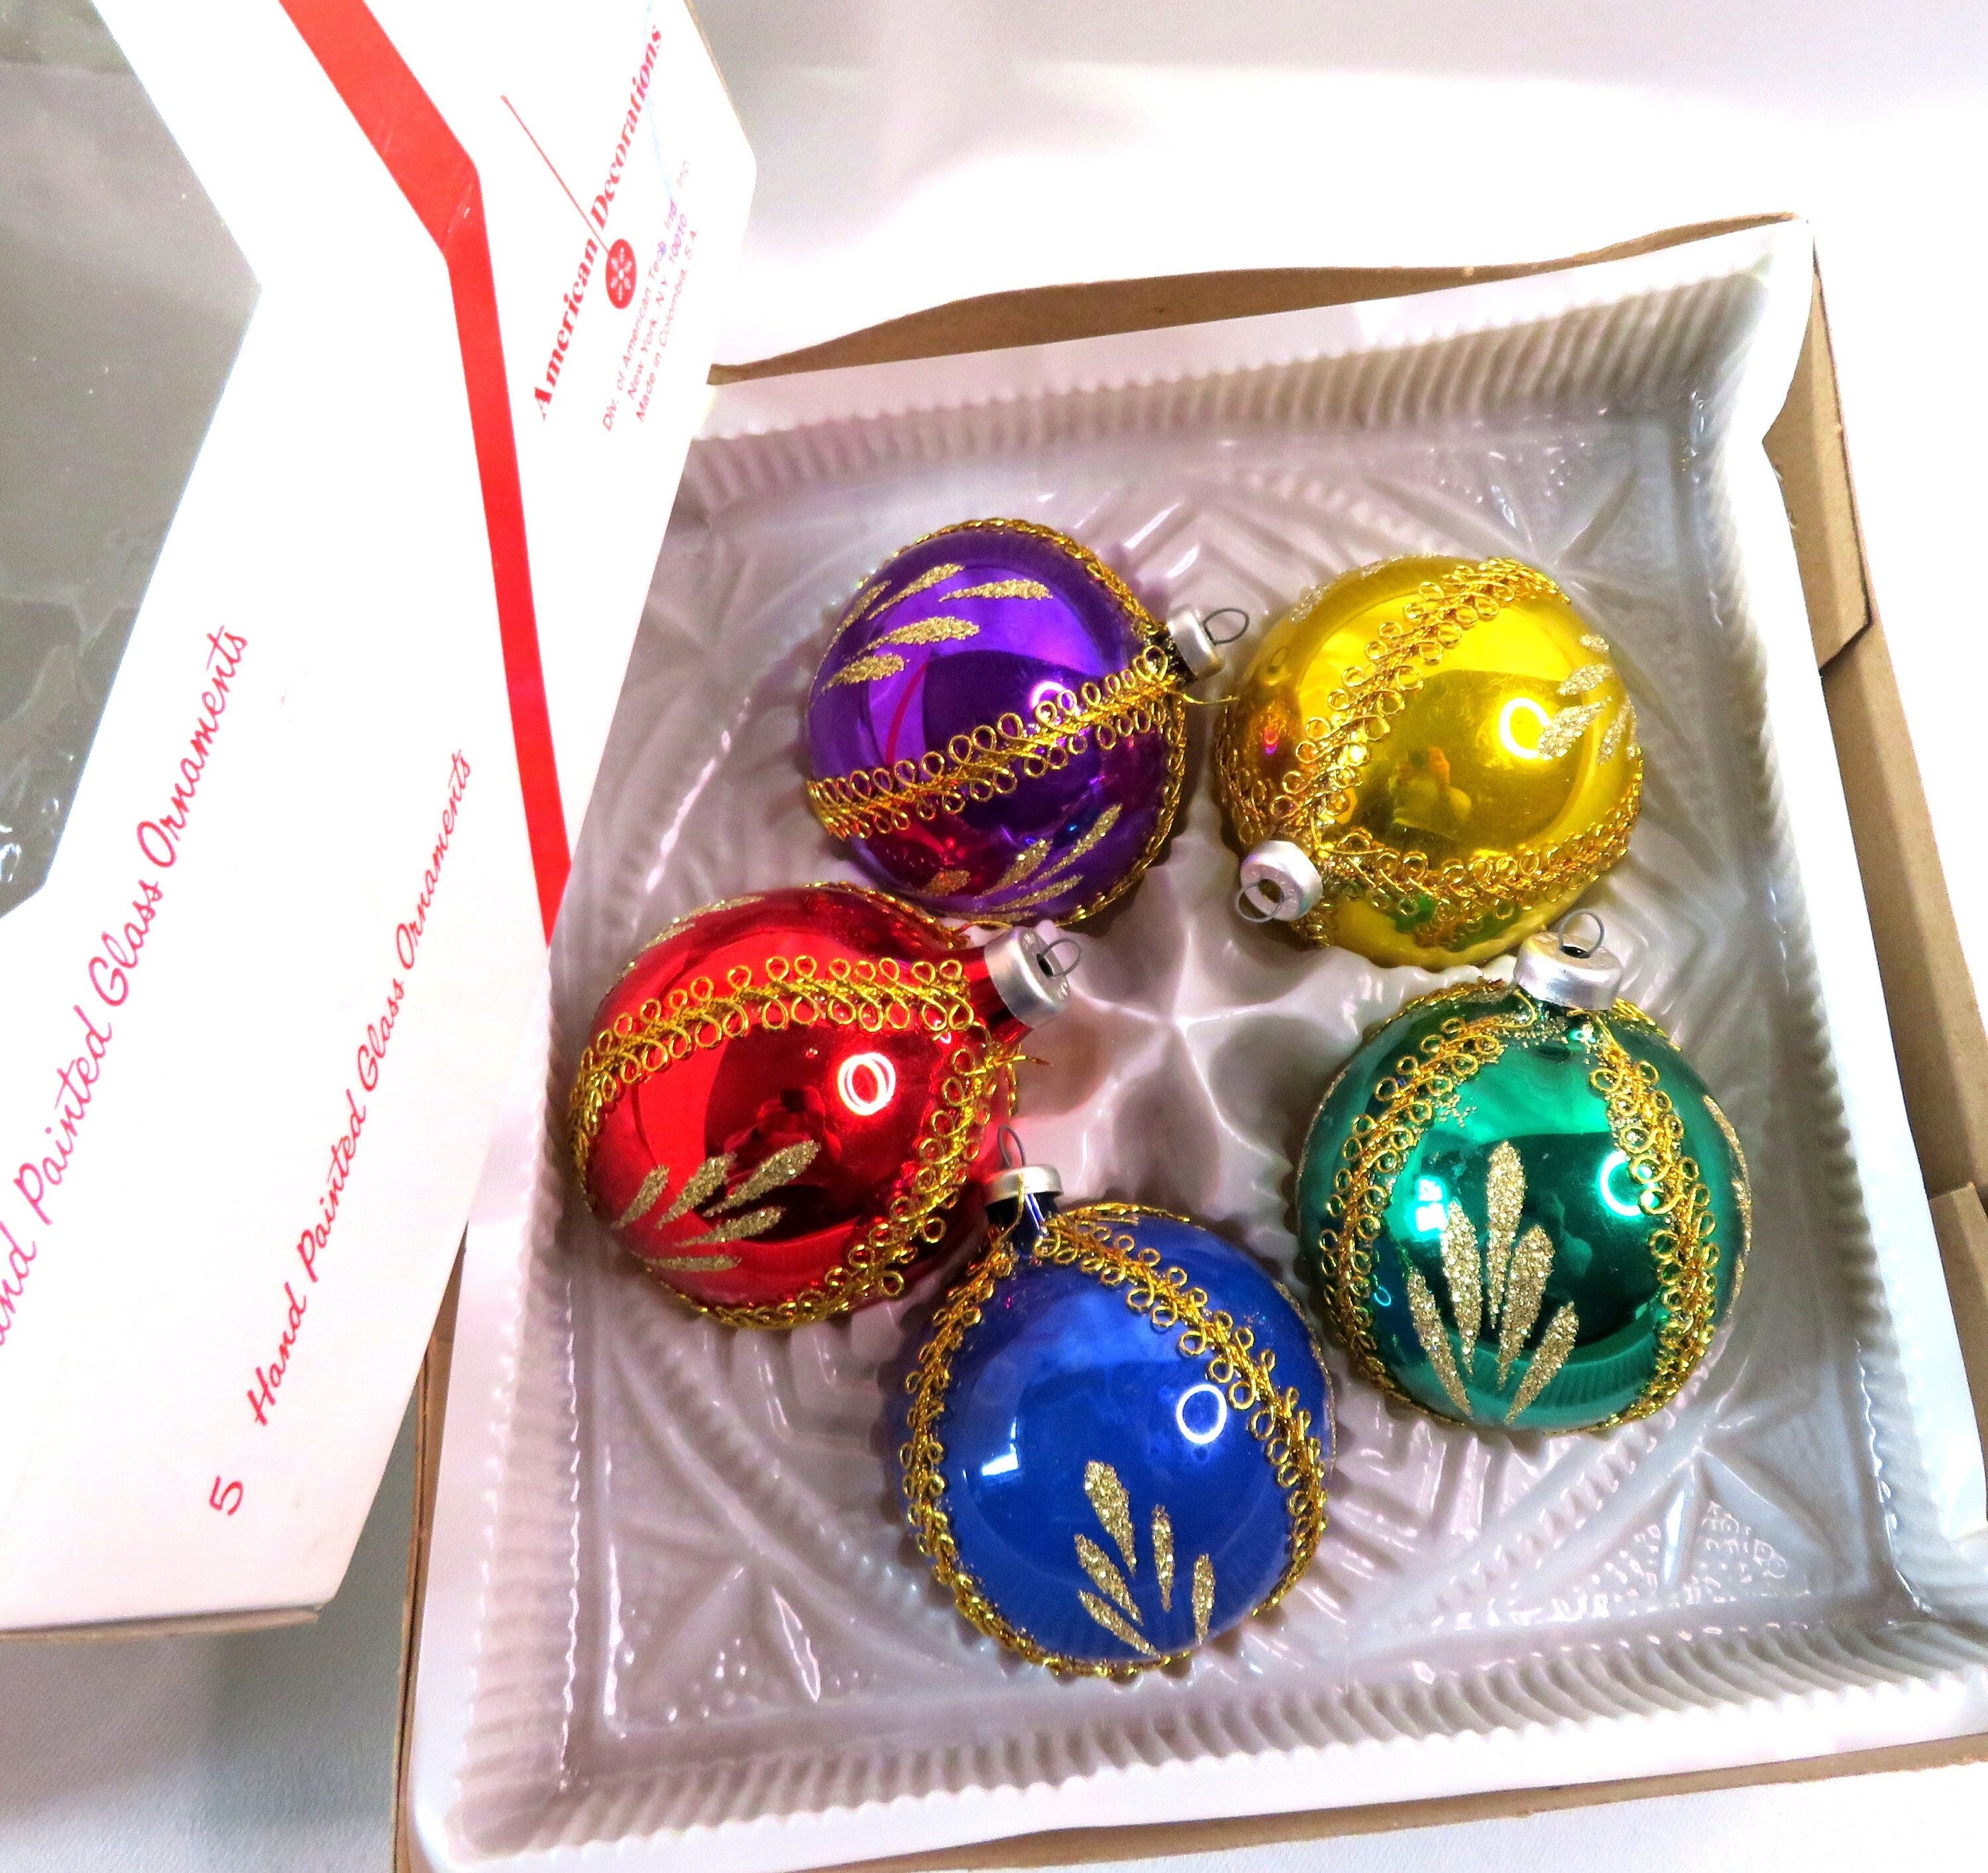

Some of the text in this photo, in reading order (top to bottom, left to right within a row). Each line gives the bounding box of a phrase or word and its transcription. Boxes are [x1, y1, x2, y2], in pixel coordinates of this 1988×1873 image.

[533, 25, 662, 421] American Decorations
[617, 369, 625, 391] of
[623, 287, 652, 370] American
[628, 360, 643, 400] New
[636, 372, 655, 423] Made
[653, 352, 661, 368] in
[13, 1004, 113, 1226] Painted
[87, 879, 164, 1008] Glass
[136, 624, 249, 869] Ornaments
[208, 749, 472, 1517] 5 Hand Painted Glass Ornaments
